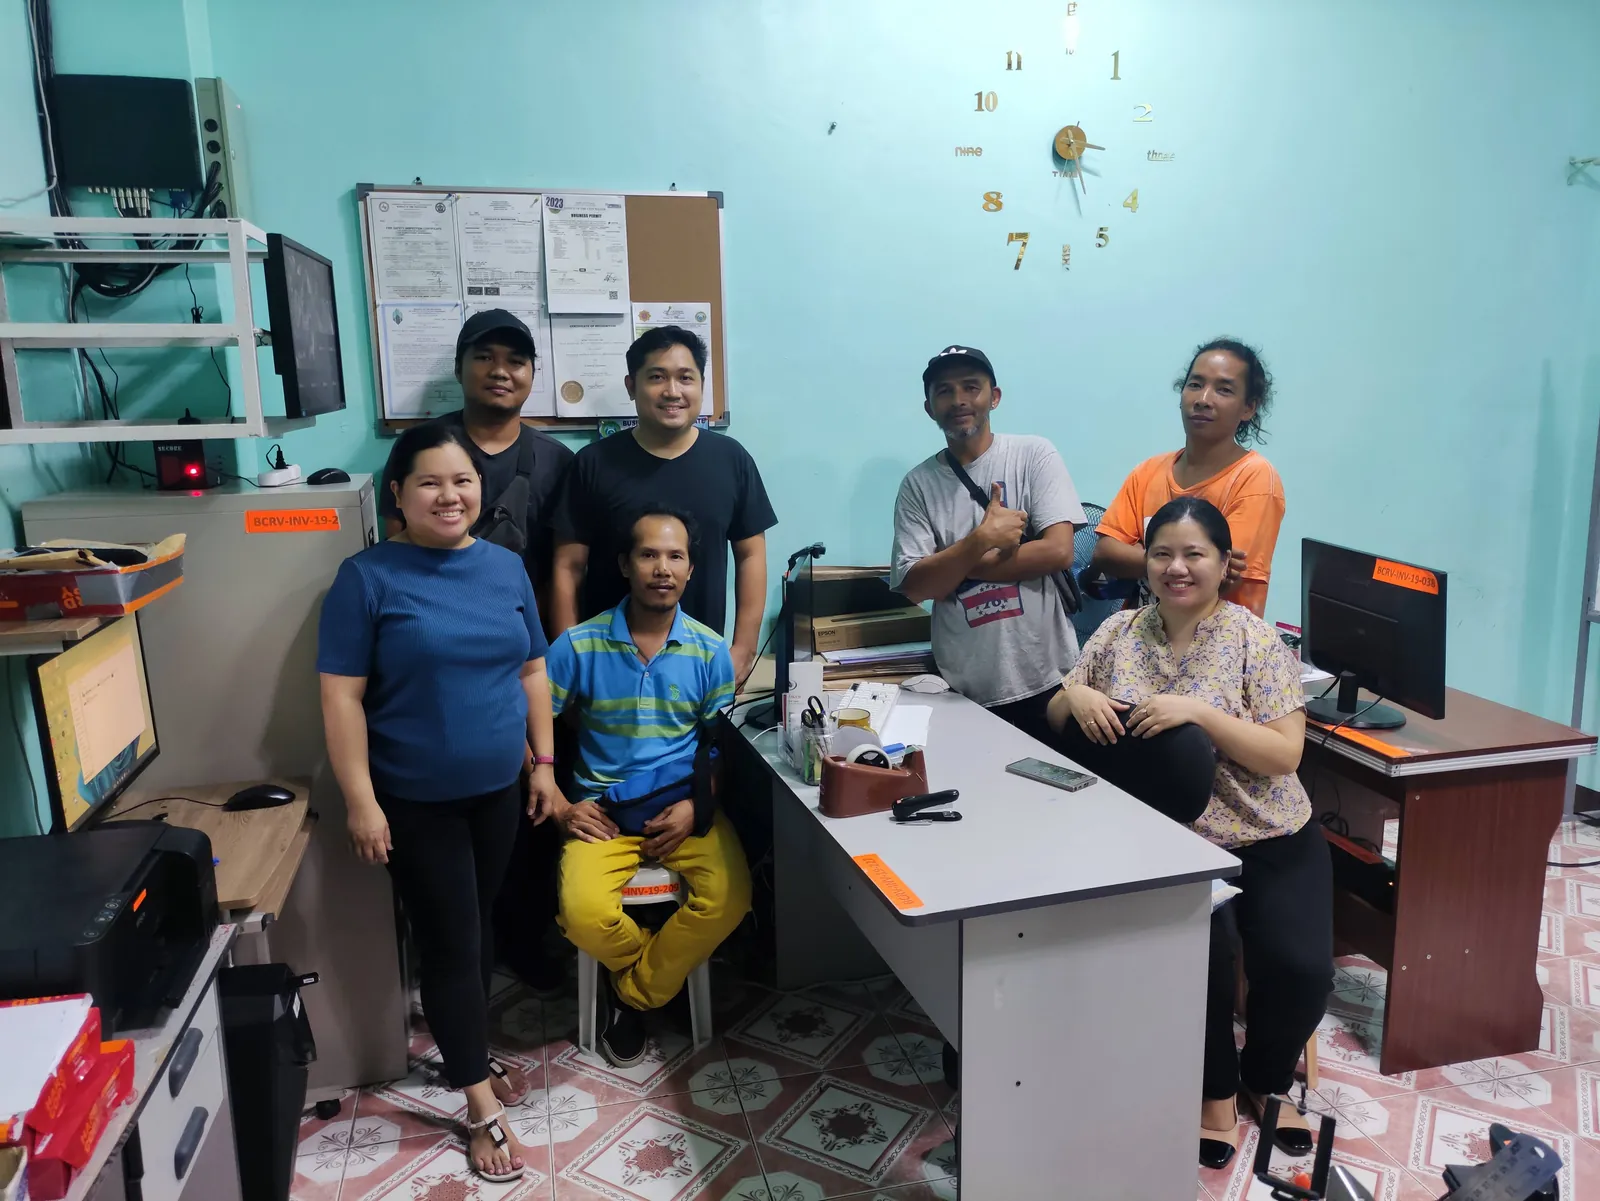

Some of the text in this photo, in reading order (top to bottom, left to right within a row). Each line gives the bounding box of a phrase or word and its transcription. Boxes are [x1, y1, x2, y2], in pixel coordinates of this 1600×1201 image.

[1005, 51, 1022, 70] 11
[1110, 50, 1121, 80] 1
[974, 91, 998, 112] 10
[1133, 103, 1153, 122] 2
[955, 147, 983, 157] nine
[545, 196, 564, 209] 2023
[982, 191, 1003, 212] 8
[1123, 188, 1139, 213] 4
[1095, 227, 1109, 248] 5
[1006, 232, 1031, 270] 7
[818, 629, 836, 637] EPSON
[623, 883, 680, 896] -INV-19-209
